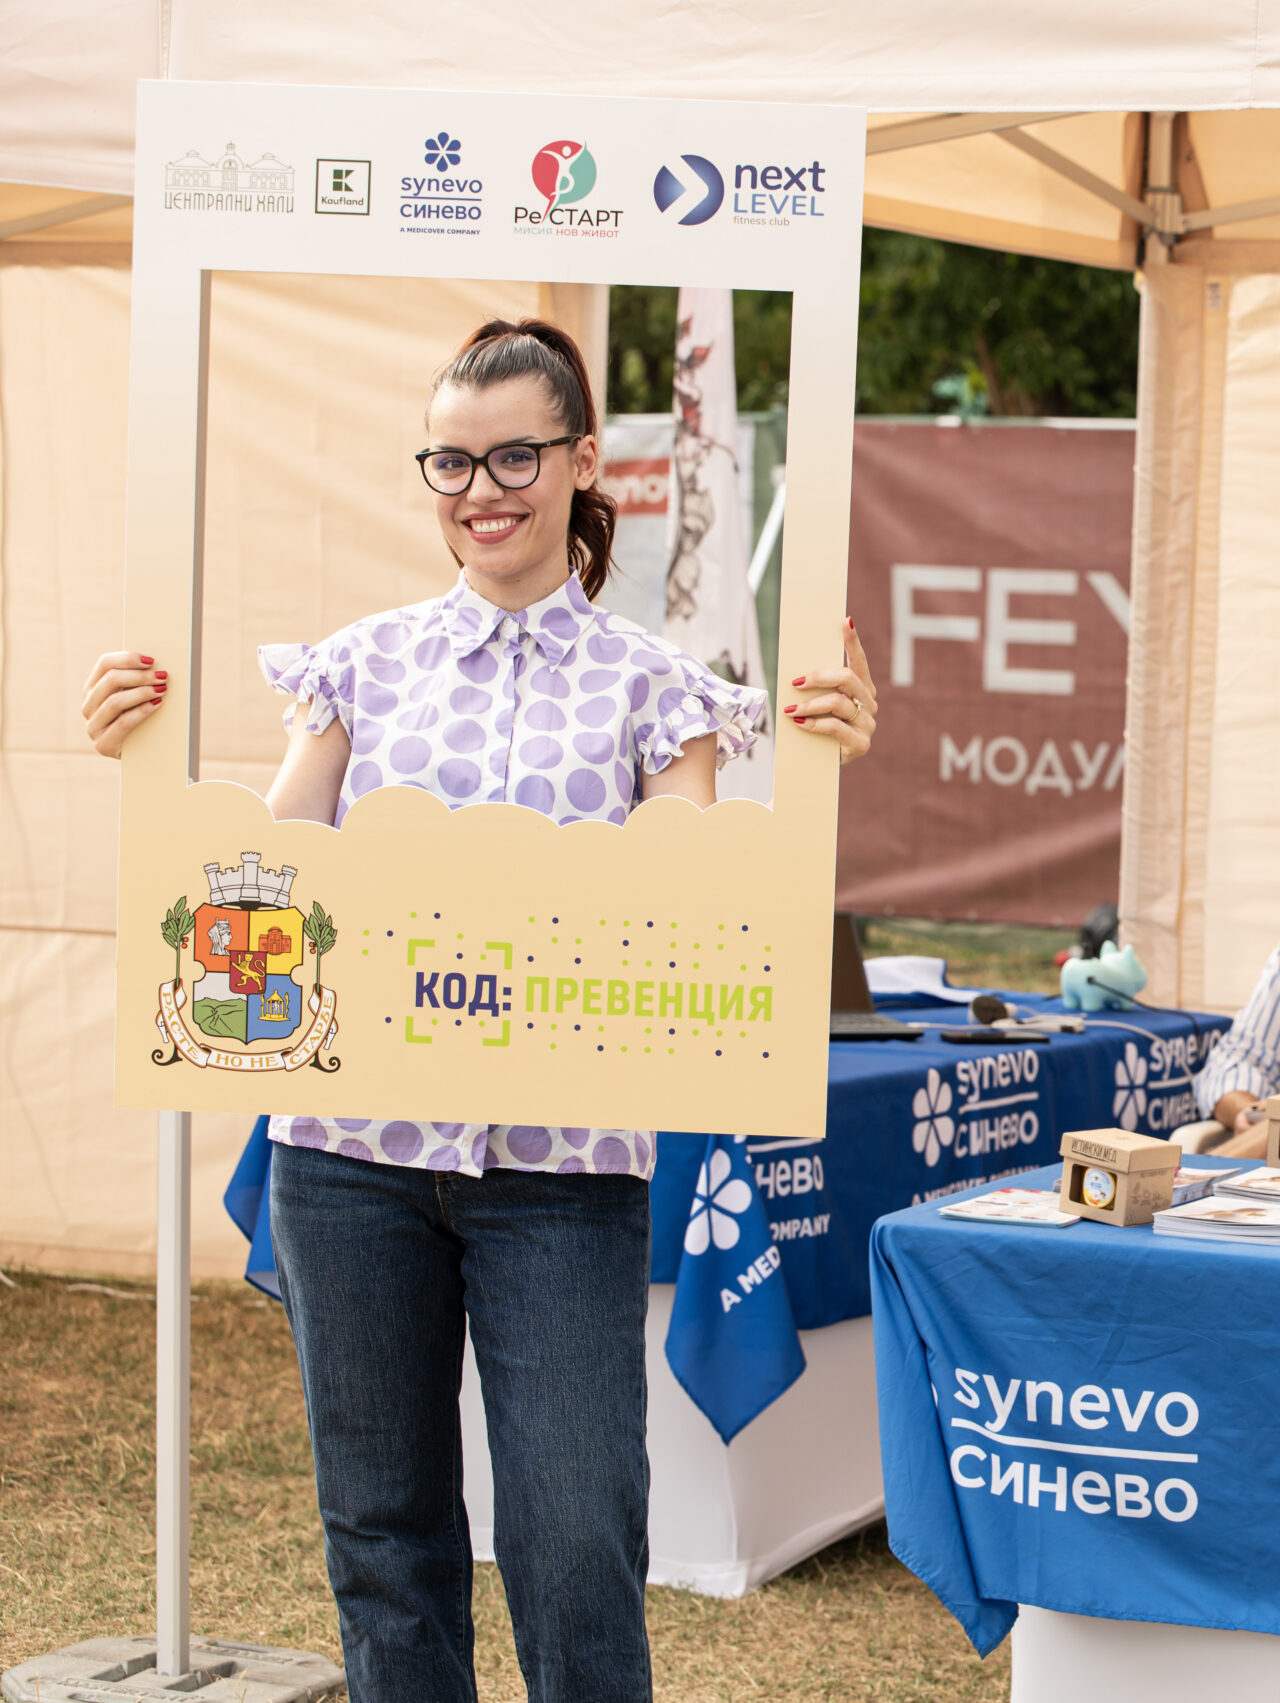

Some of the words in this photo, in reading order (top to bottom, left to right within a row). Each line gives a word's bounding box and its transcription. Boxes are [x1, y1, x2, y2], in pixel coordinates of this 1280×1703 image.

[400, 176, 483, 197] synevo
[734, 160, 826, 193] next
[164, 191, 252, 212] ЦЕНТРАЛНИ
[256, 194, 294, 214] ХАЛИ
[321, 195, 364, 206] Kaufland
[733, 192, 825, 217] LEVEL
[406, 227, 445, 235] MEDICOVER
[446, 228, 481, 236] COMPANY
[513, 226, 553, 236] МИСИЯ
[555, 228, 579, 237] НОВ
[581, 229, 620, 239] ЖИВОТ
[733, 215, 767, 226] fitness
[768, 217, 790, 227] club
[414, 971, 513, 1018] КОД:
[525, 975, 774, 1027] ПРЕВЕНЦИЯ
[162, 992, 200, 1061] РАСТЕ
[215, 1053, 243, 1068] НО
[250, 1055, 279, 1068] НЕ
[956, 1048, 1039, 1104] synevo
[1071, 1137, 1104, 1159] ИСТИНСКИ
[1103, 1147, 1118, 1164] МЕД
[719, 1287, 742, 1313] A
[953, 1367, 1199, 1437] synevo
